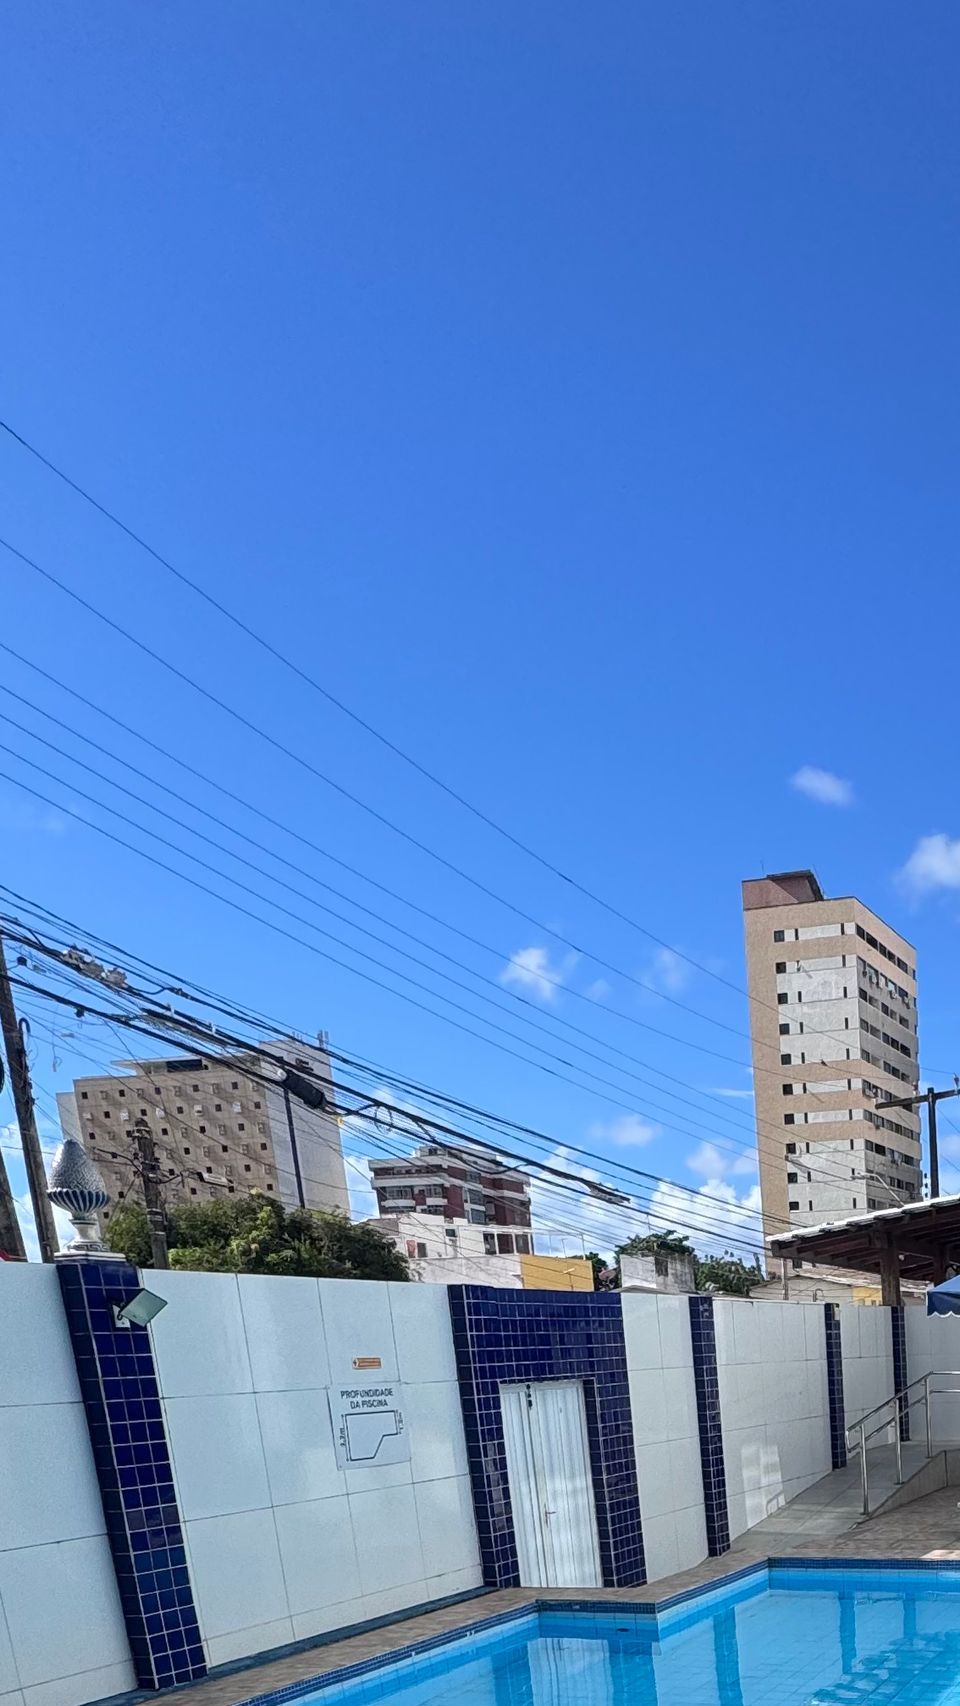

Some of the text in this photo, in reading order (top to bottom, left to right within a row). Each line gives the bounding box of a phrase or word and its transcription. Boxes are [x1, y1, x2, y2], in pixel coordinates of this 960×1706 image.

[340, 1388, 393, 1399] PROFUNDIDADE
[350, 1399, 388, 1409] DA PISCINA
